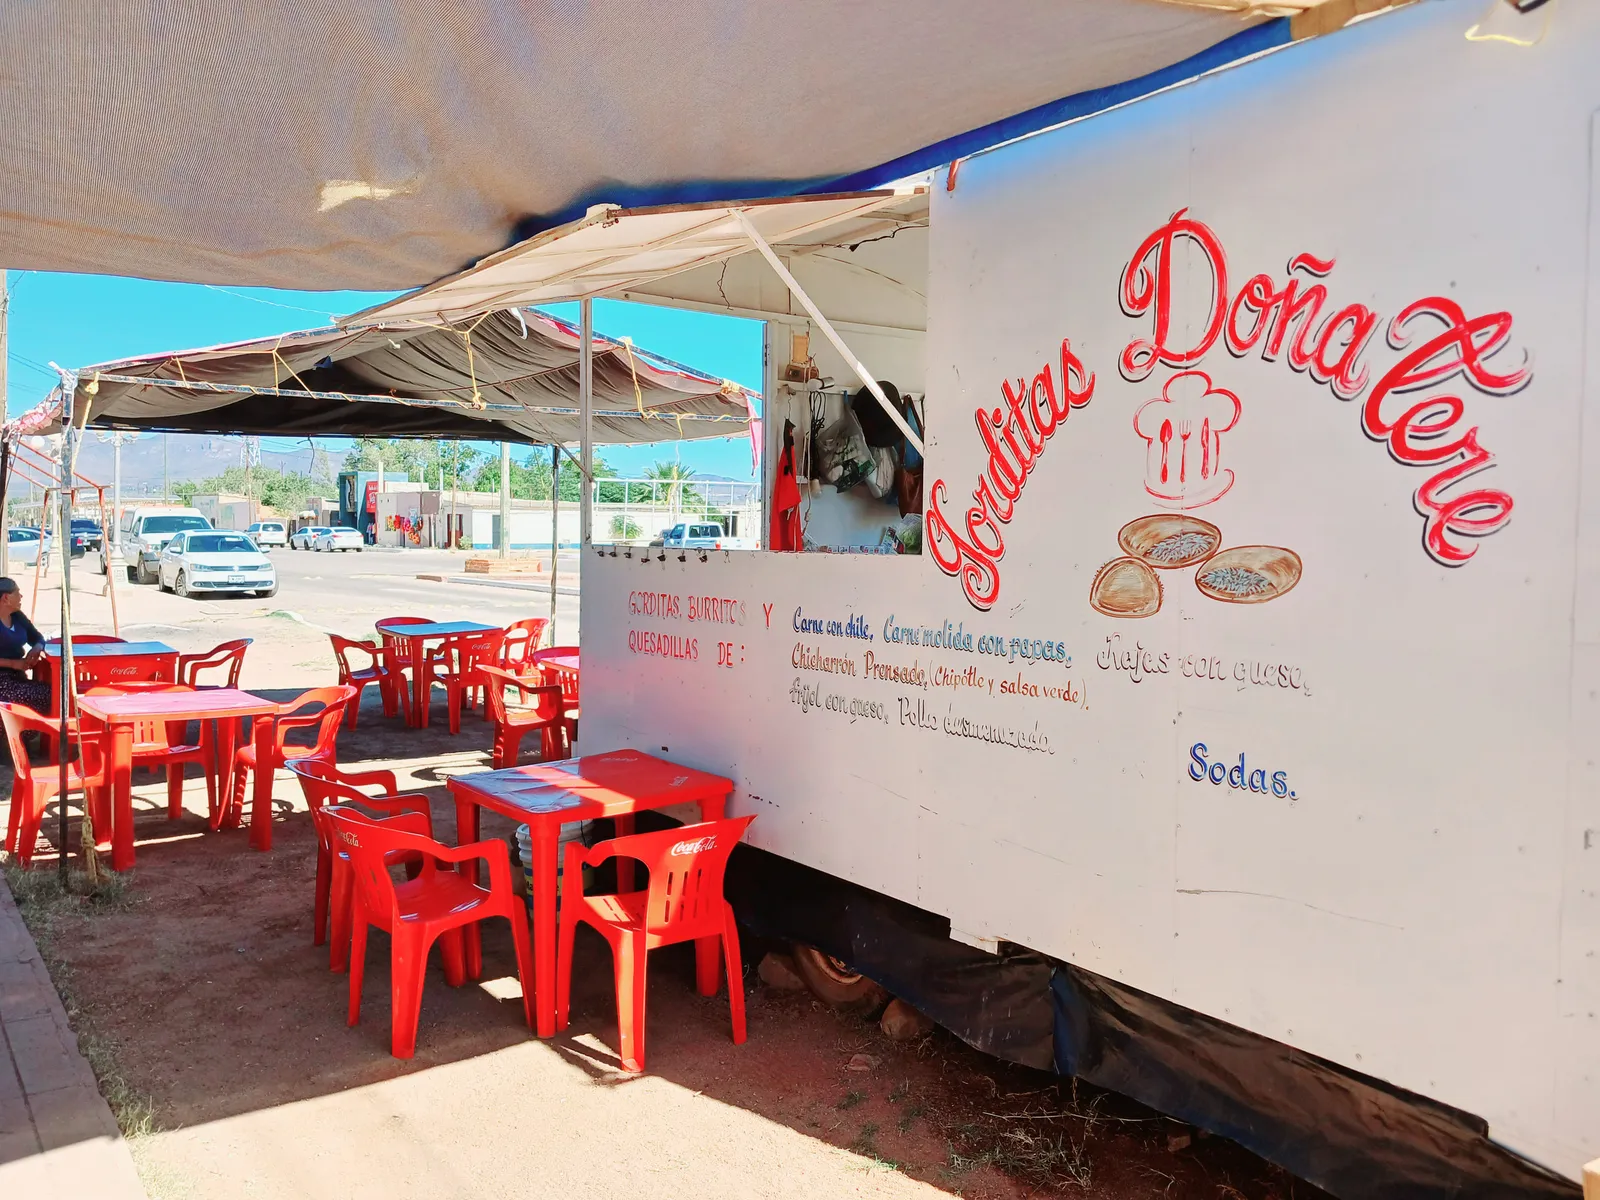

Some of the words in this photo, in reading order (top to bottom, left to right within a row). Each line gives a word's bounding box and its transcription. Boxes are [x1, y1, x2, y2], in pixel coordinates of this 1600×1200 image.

[926, 337, 1096, 612] Gorditas
[1118, 207, 1384, 402] Doña
[762, 602, 774, 629] Y
[793, 606, 824, 635] Carne
[826, 616, 844, 635] con
[628, 630, 699, 661] QUESADILLAS
[883, 614, 921, 645] Carne
[921, 618, 974, 653] molida
[977, 635, 1007, 656] con
[791, 642, 857, 677] Chicharrón
[987, 678, 995, 696] y
[1000, 672, 1039, 698] salsa
[1096, 631, 1171, 684] Rajas
[1177, 652, 1227, 681] con
[825, 693, 848, 714] con
[897, 697, 938, 731] Pollo
[1187, 742, 1299, 800] Sodas.
